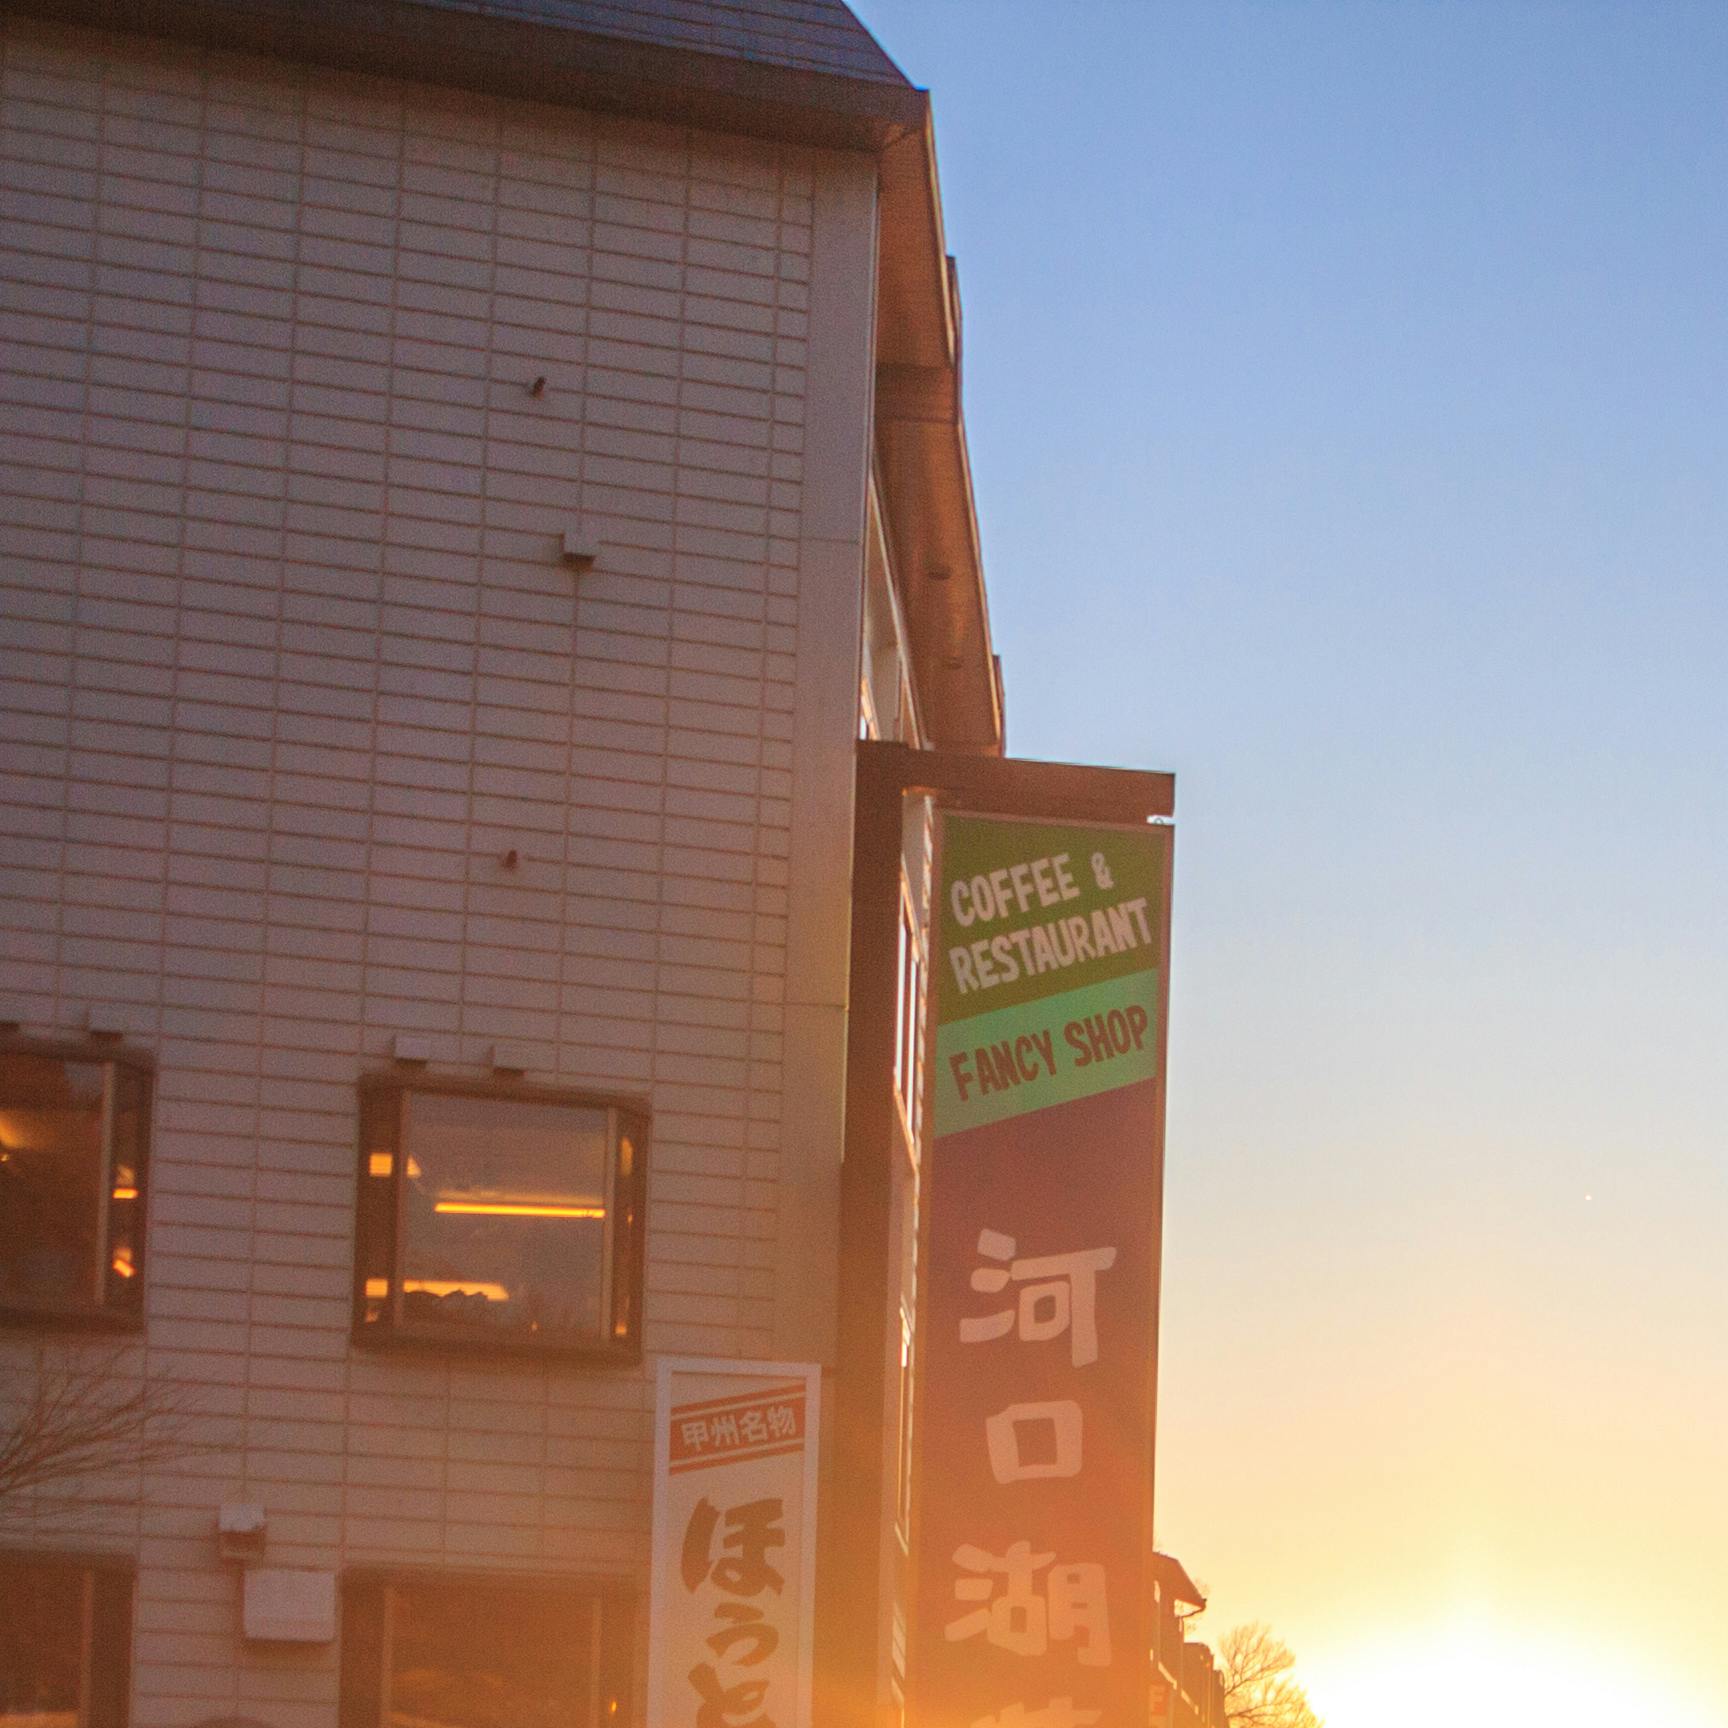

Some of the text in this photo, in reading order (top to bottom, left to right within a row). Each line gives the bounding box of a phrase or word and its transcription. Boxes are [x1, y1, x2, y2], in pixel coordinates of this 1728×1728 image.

[949, 851, 1114, 928] COFFEE &
[948, 897, 1153, 996] RESTAURANT
[948, 1004, 1149, 1102] FANCY SHOP
[681, 1404, 797, 1454] 甲州名物
